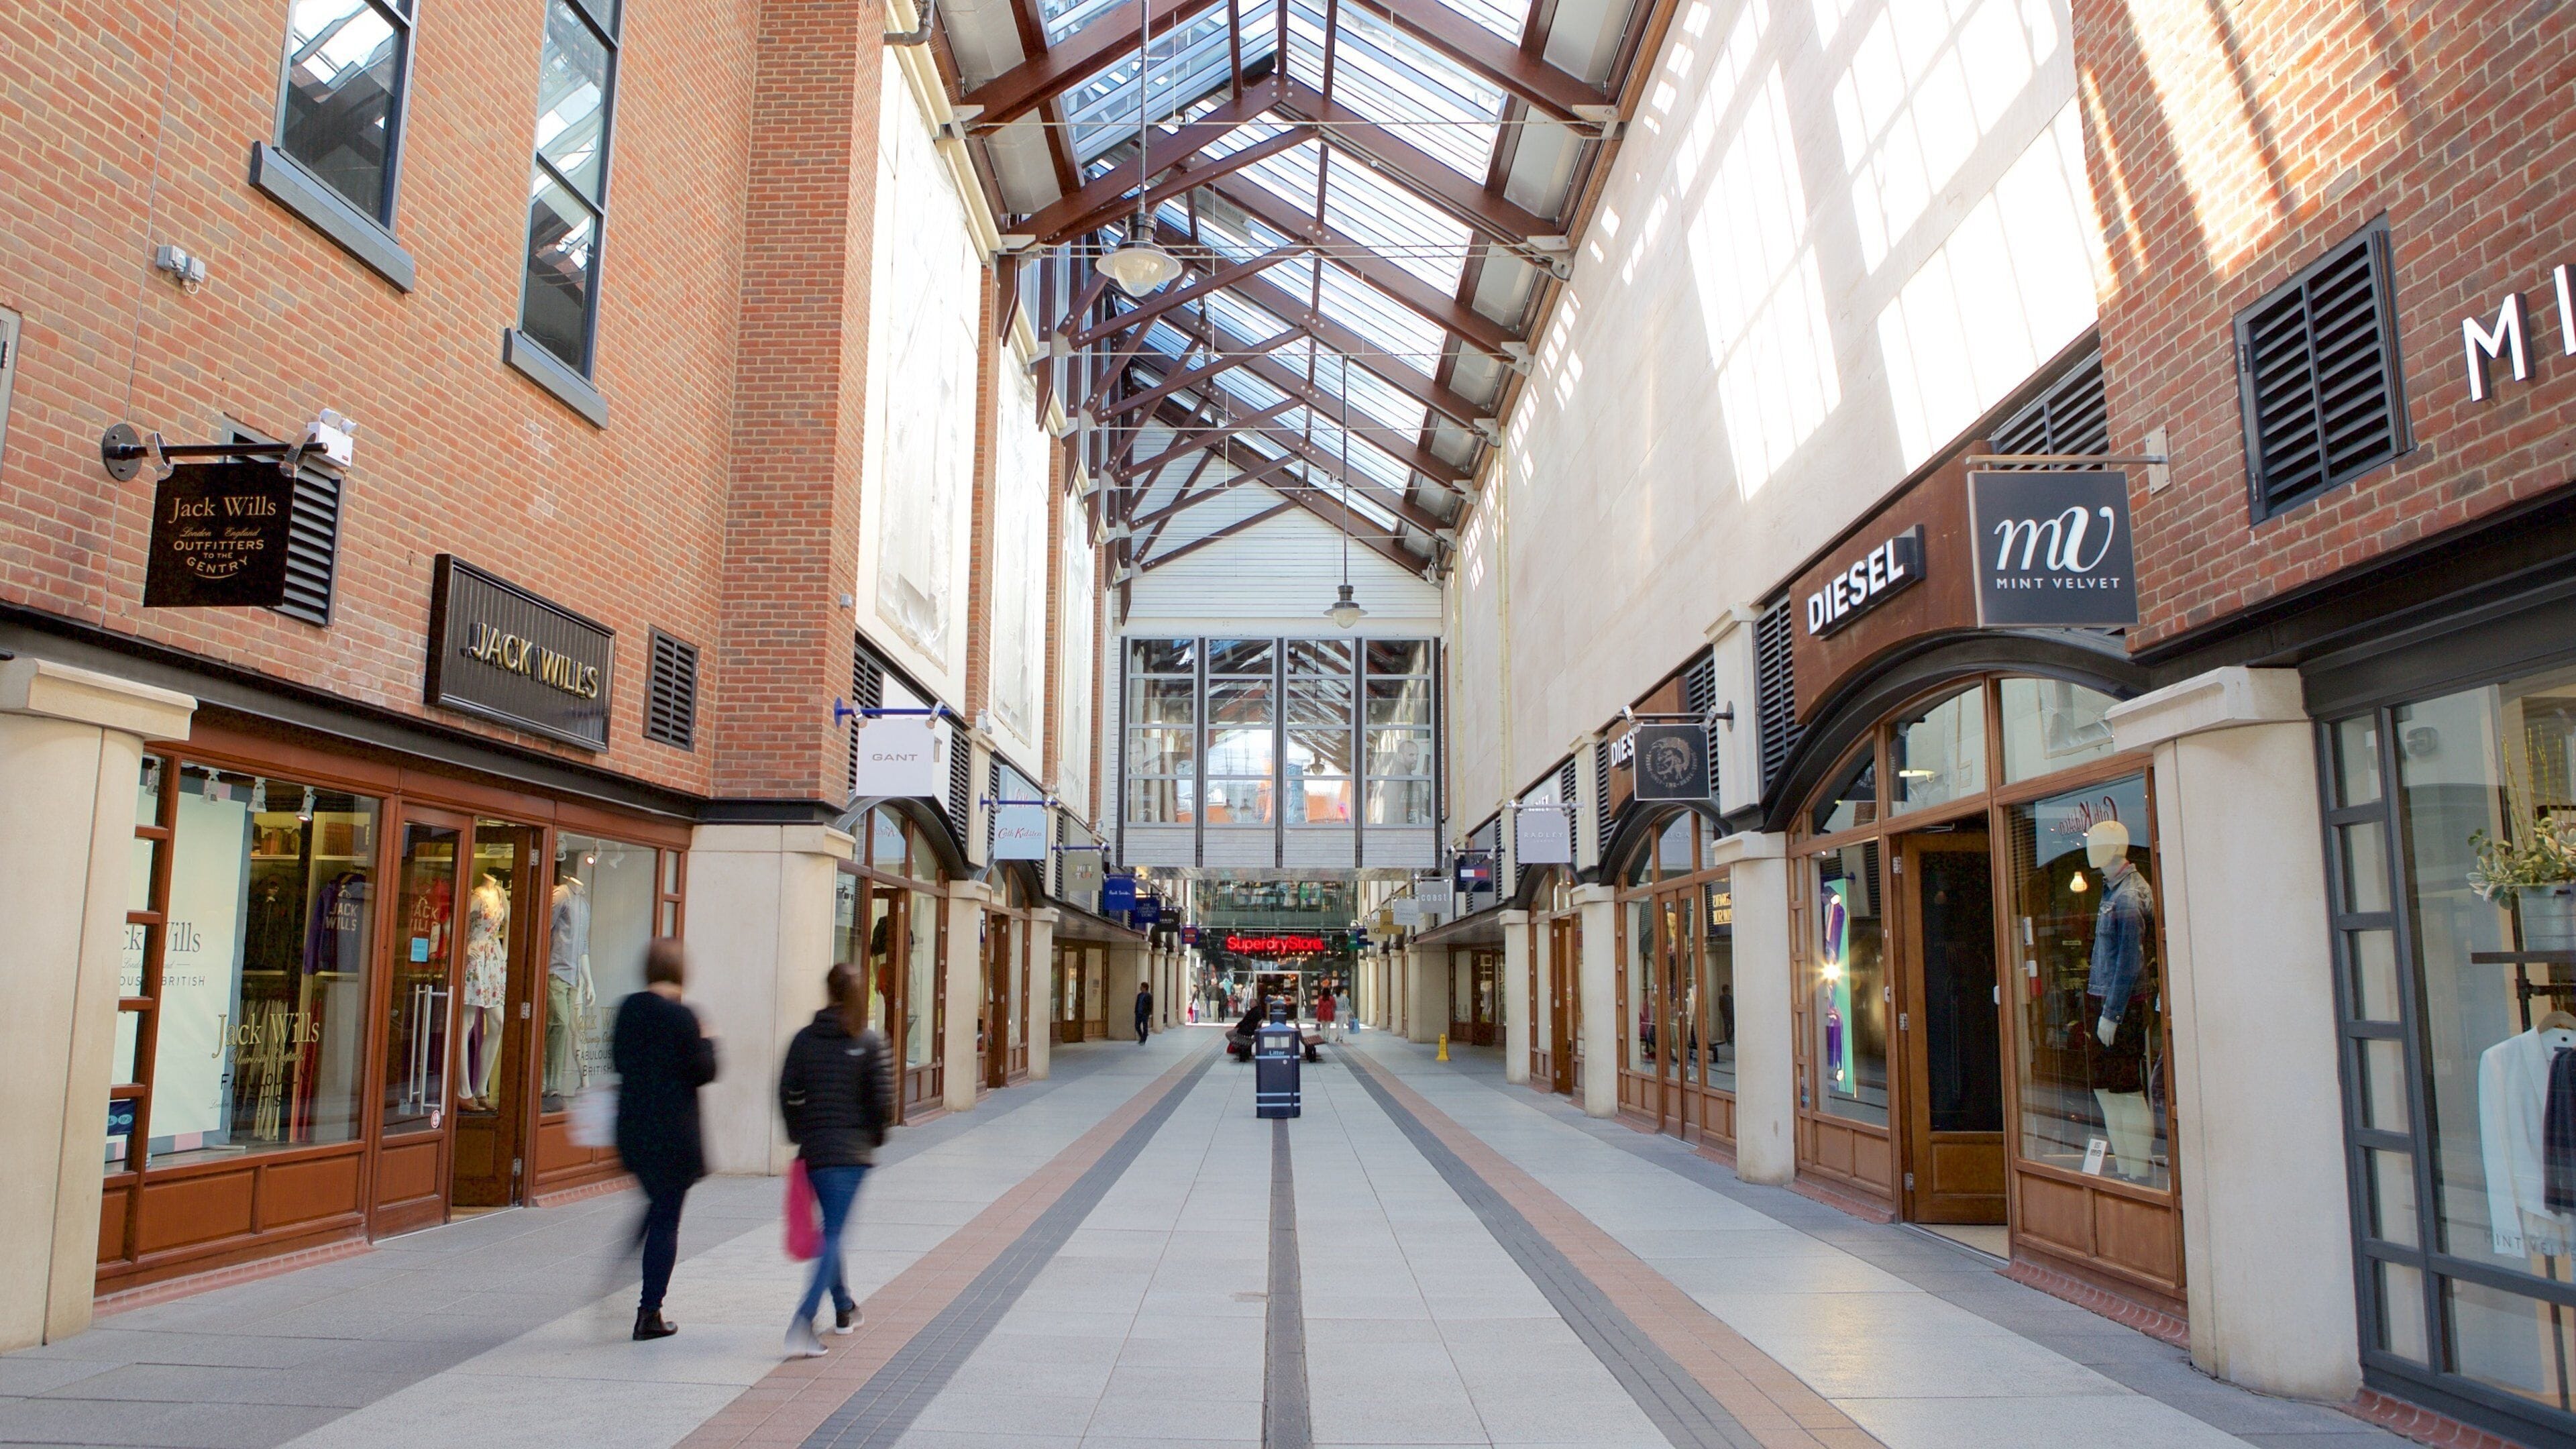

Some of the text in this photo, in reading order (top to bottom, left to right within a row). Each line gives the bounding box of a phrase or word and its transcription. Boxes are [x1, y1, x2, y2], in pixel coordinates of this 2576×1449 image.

[168, 496, 276, 523] Jack Wills
[180, 527, 261, 539] London England
[174, 539, 264, 551] OUTFITTERS
[186, 555, 249, 574] GENTRY
[1807, 539, 1905, 636] DIESEL
[1996, 578, 2120, 590] MINT VELVET
[470, 623, 598, 700] JACK WILLS
[1611, 730, 1635, 767] DIES
[872, 753, 918, 761] GANT
[998, 827, 1042, 839] Cath Kidston
[1421, 894, 1447, 902] coast
[329, 902, 359, 917] JACK
[413, 904, 439, 920] ACK
[326, 916, 358, 931] WILLS
[162, 975, 205, 987] BRITISH
[211, 1012, 320, 1059] Jack Wills
[576, 1049, 612, 1061] FABULOUS
[582, 1063, 612, 1077] BRITISH
[2484, 1232, 2521, 1249] MINT
